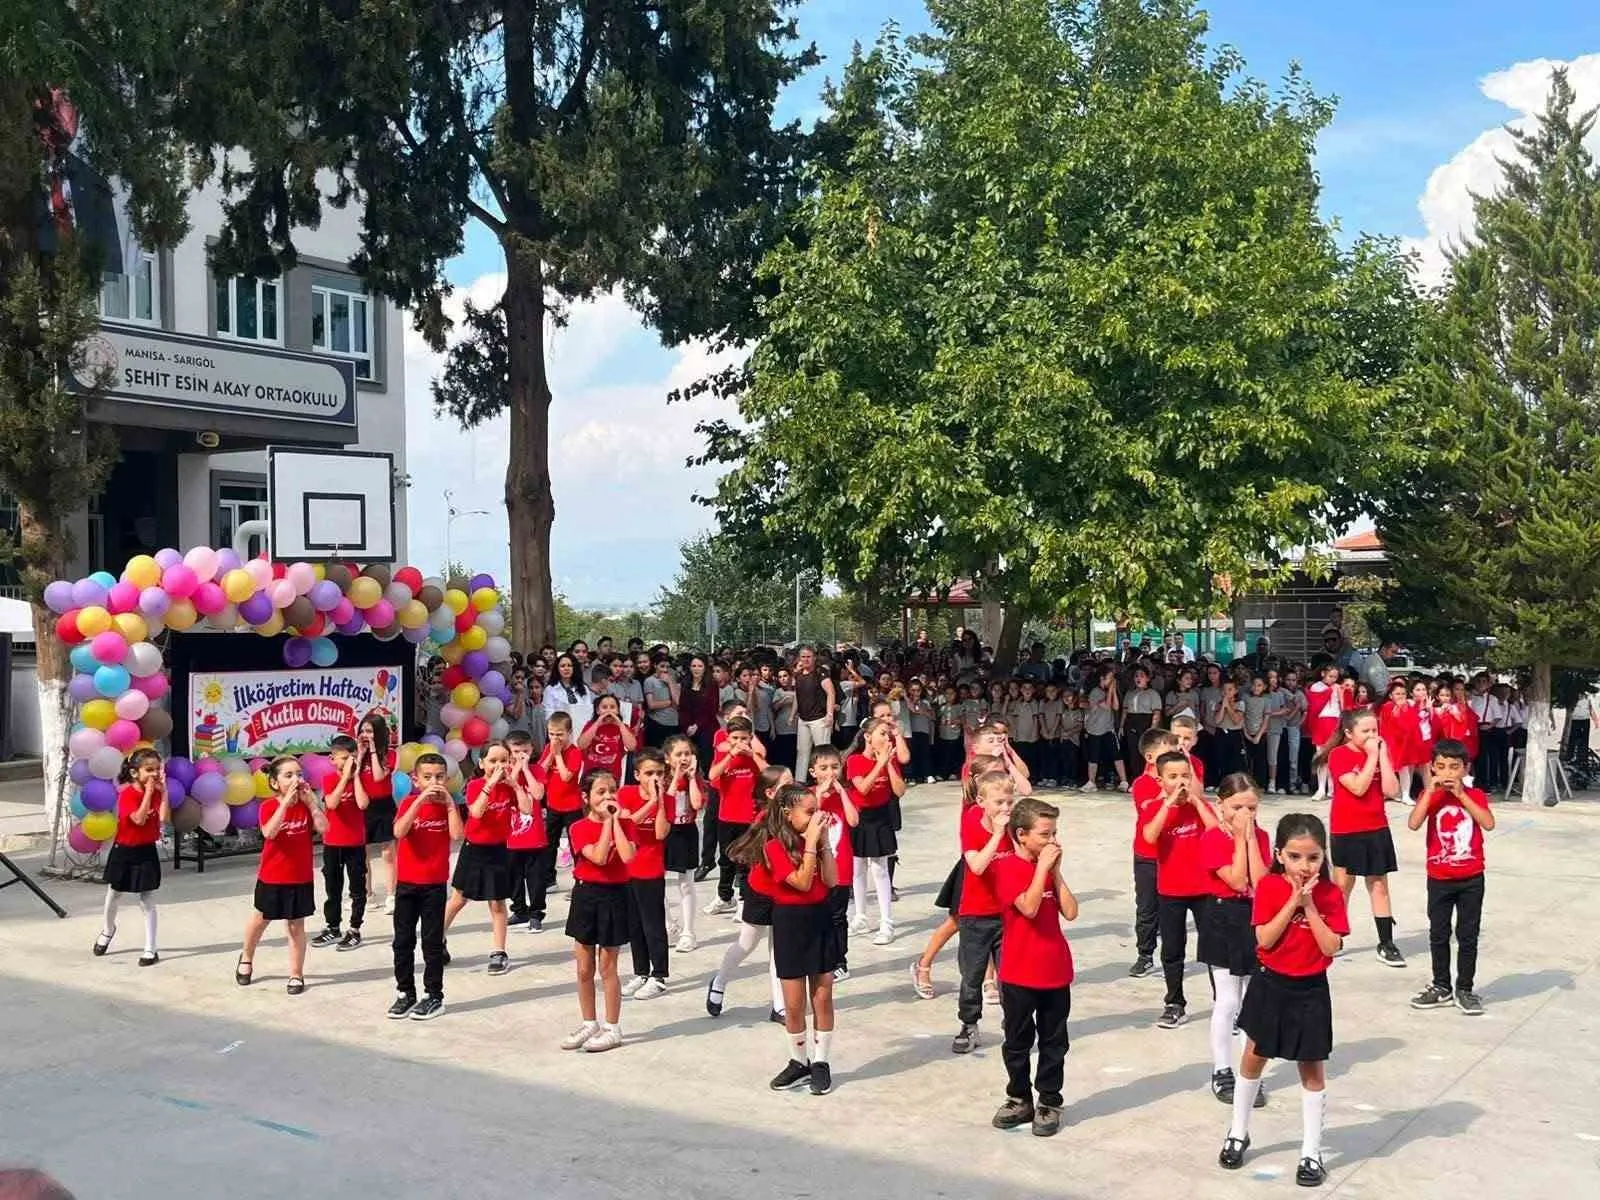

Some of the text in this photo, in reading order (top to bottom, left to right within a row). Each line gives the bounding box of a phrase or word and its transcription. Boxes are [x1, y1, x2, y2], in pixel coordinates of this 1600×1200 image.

[124, 367, 339, 408] ŞEHİT ESİN AKAY ORTAOKULU
[233, 675, 373, 712] İlköğretim Haftası
[261, 702, 345, 731] Kutlu Olsun
